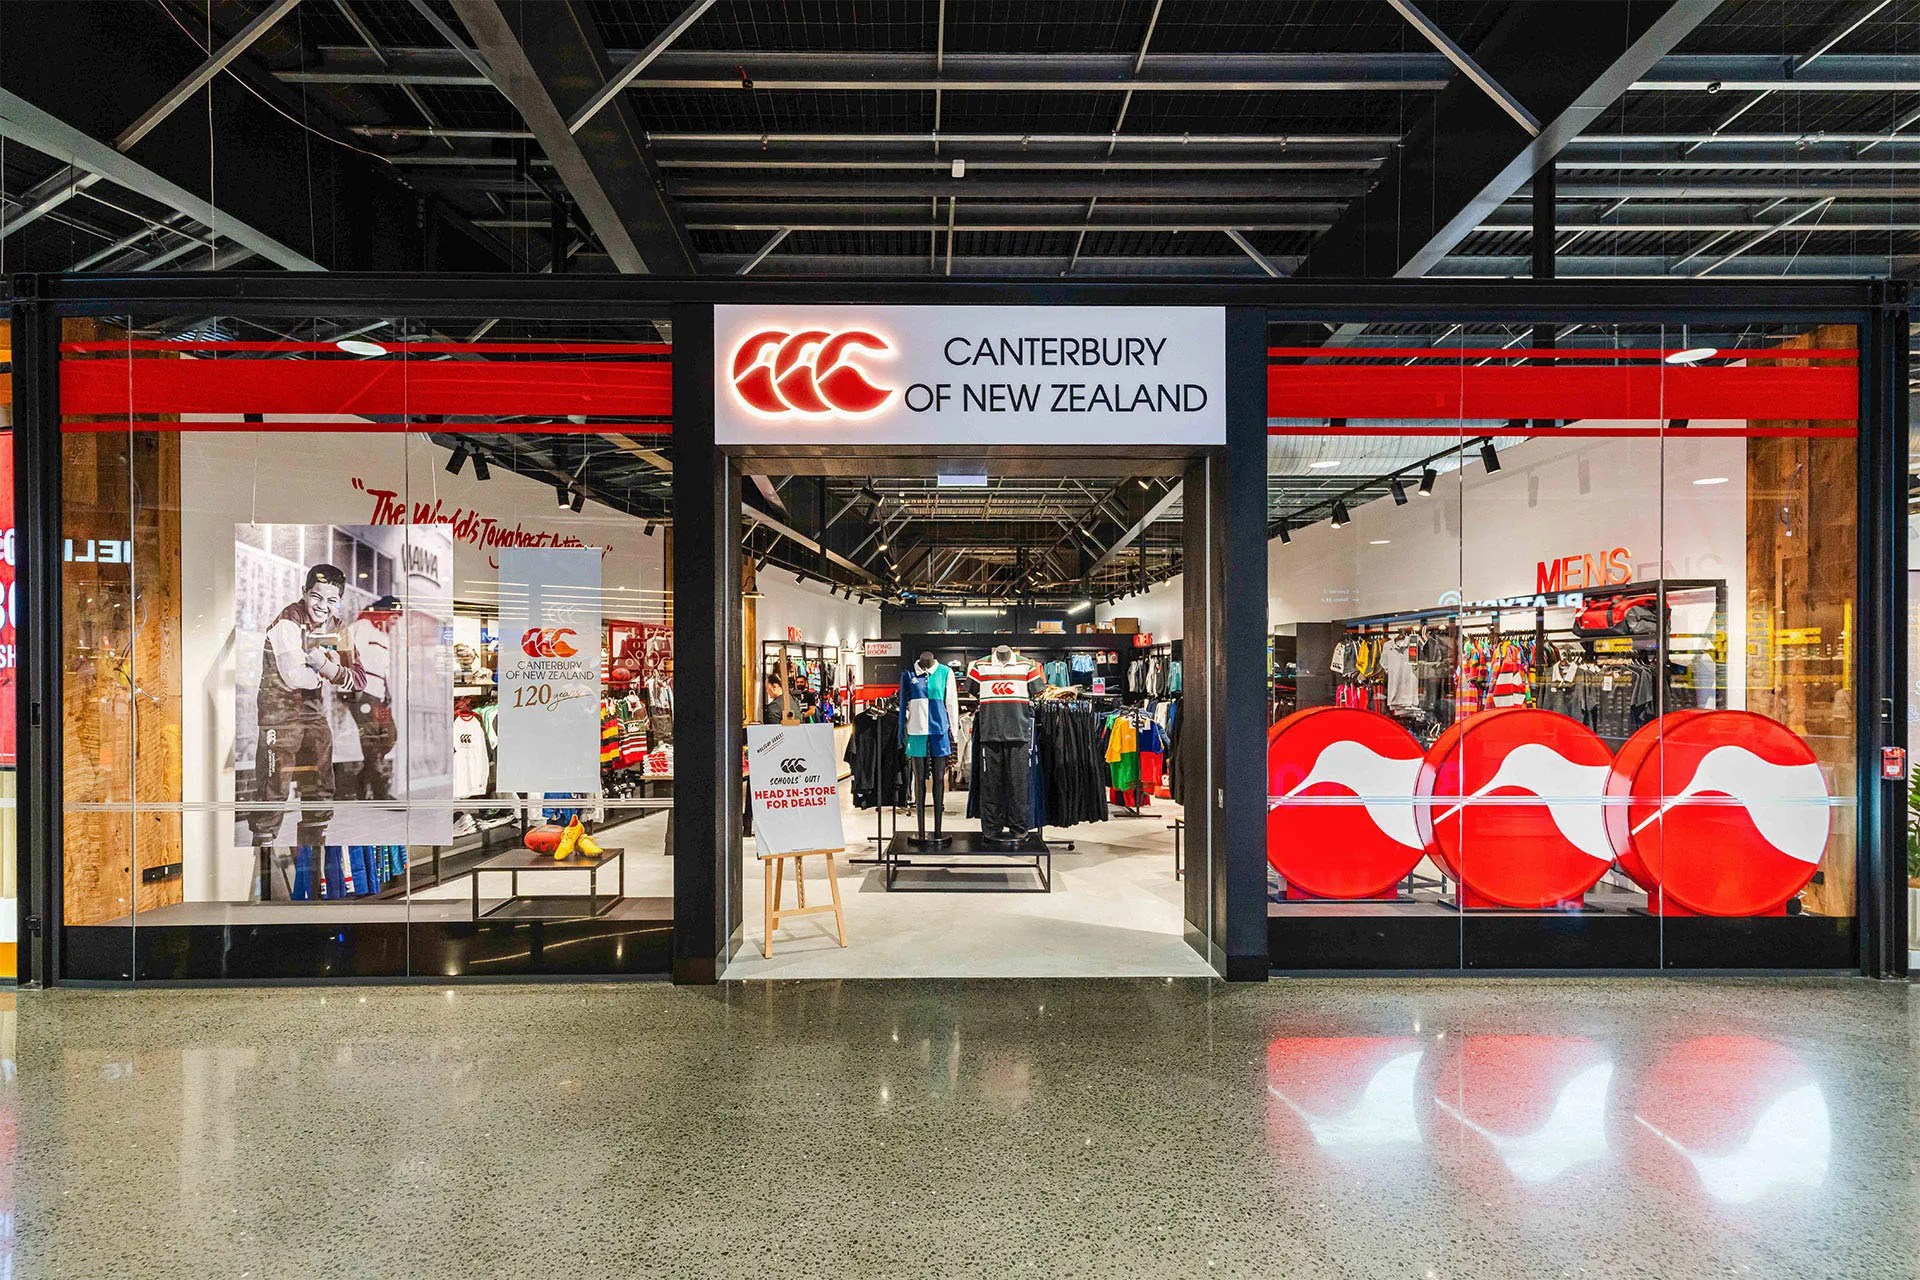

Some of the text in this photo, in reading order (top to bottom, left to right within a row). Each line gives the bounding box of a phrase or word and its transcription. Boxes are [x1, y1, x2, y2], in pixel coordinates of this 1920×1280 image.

[944, 337, 1166, 366] CANTERBURY
[904, 383, 1207, 412] OF NEW ZEALAND
[1537, 547, 1632, 594] MENS
[517, 660, 582, 670] CANTERBURY
[506, 671, 595, 680] OF NEW ZEALAND
[513, 684, 551, 708] 120
[804, 775, 820, 783] OUT!
[755, 786, 836, 800] HEAD IN-STORE
[766, 797, 827, 809] FOR DEALS!
